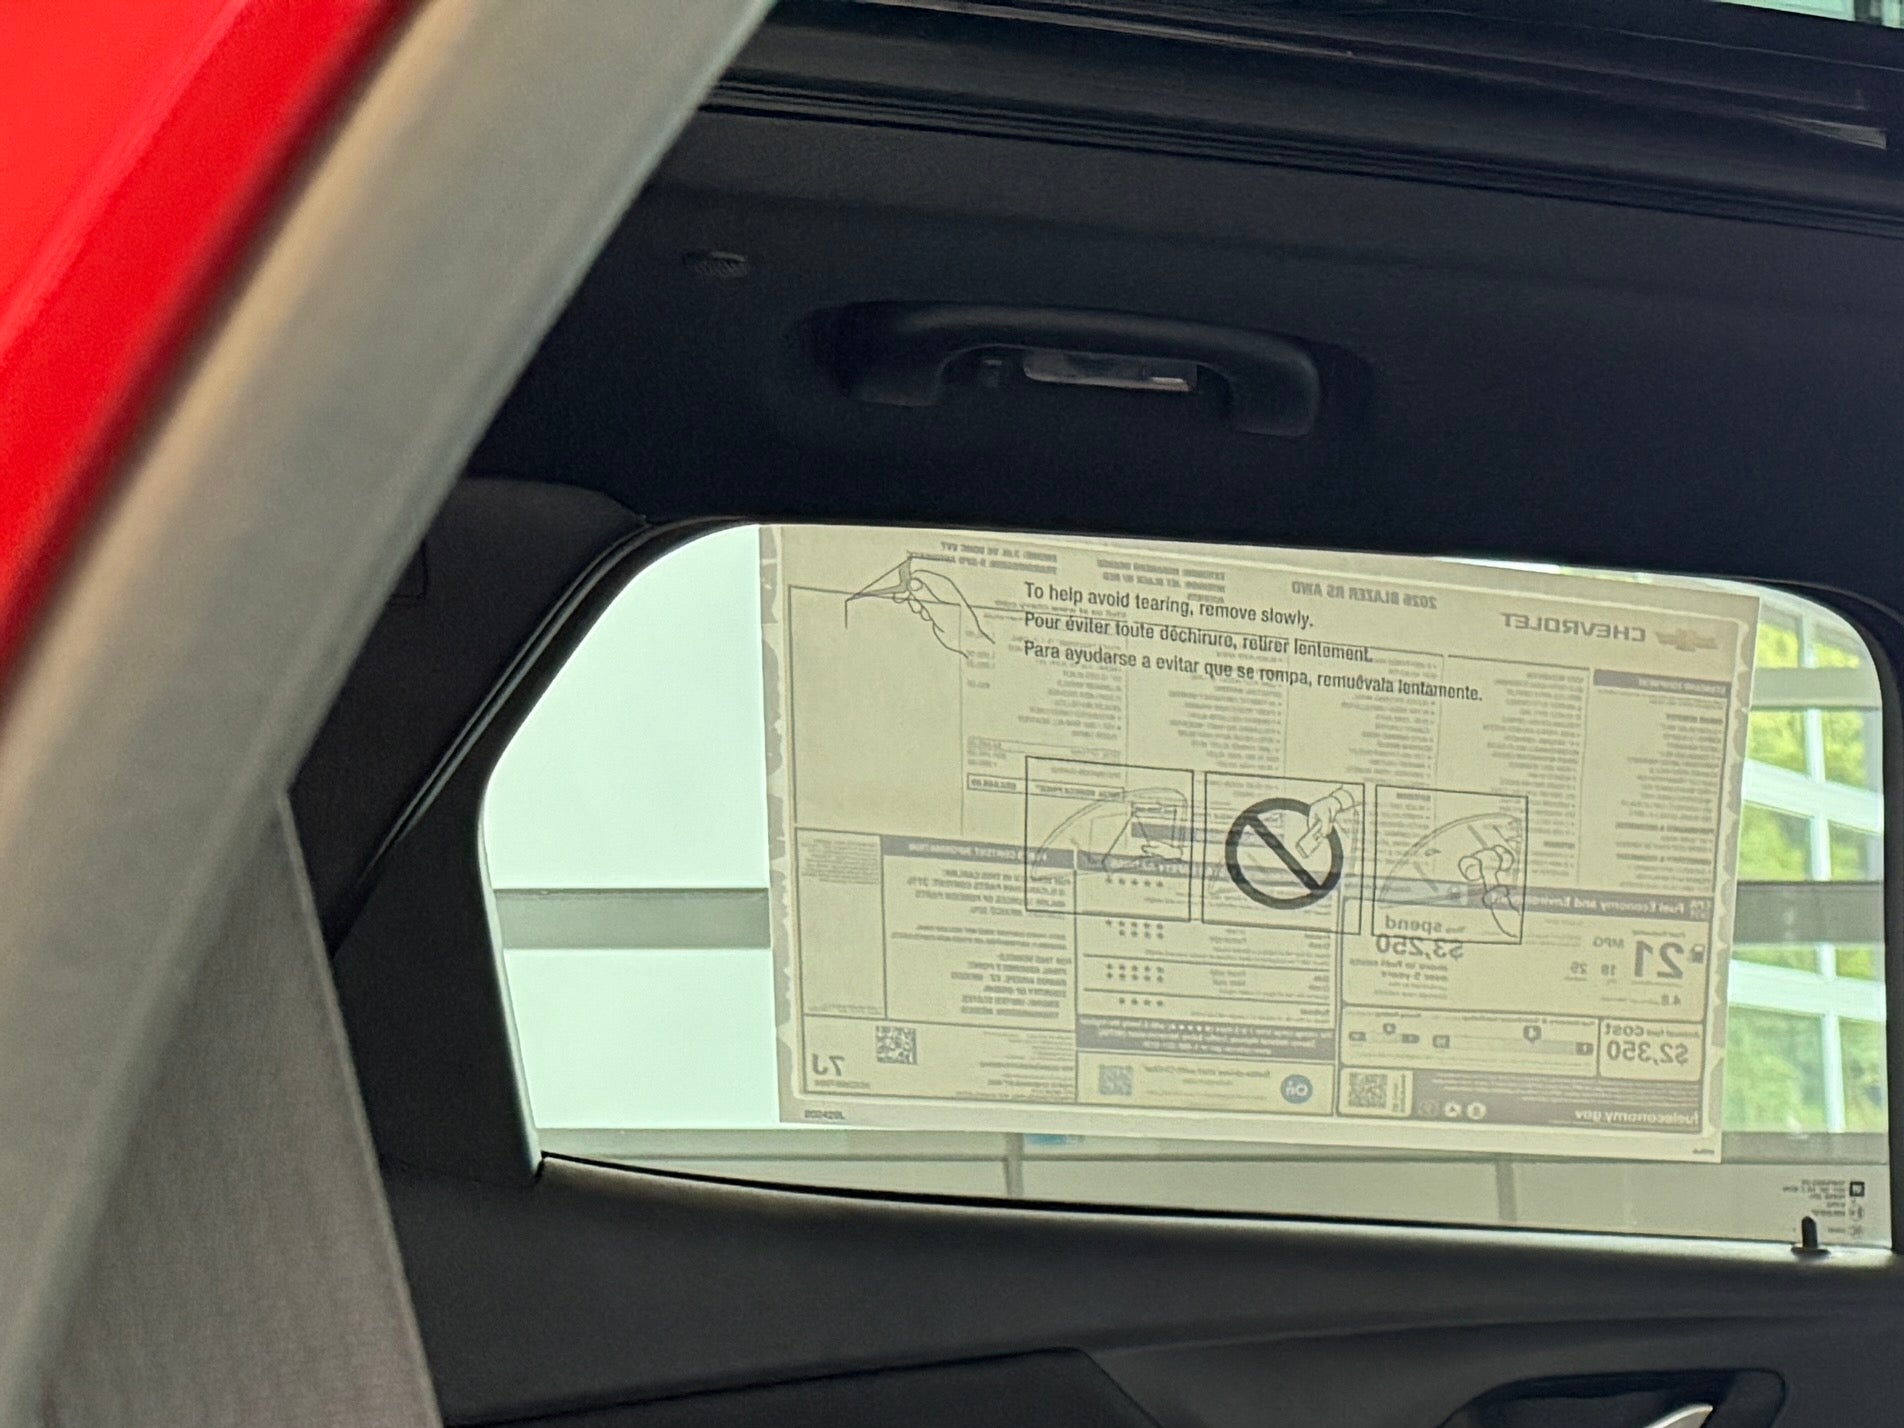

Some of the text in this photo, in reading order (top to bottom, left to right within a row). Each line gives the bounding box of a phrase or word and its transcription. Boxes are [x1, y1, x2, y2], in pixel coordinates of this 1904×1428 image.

[1025, 581, 1044, 600] To
[1049, 583, 1083, 604] help
[1088, 589, 1130, 608] avoid
[1134, 592, 1194, 618] tearing,
[1199, 603, 1257, 622] remove
[1260, 607, 1314, 631] slowly.
[1024, 611, 1374, 663] Pour éviter toute déchirure, retirer lentement.
[1024, 639, 1484, 703] Para ayudarse a evitar que se rompa, remuévala lentamente.
